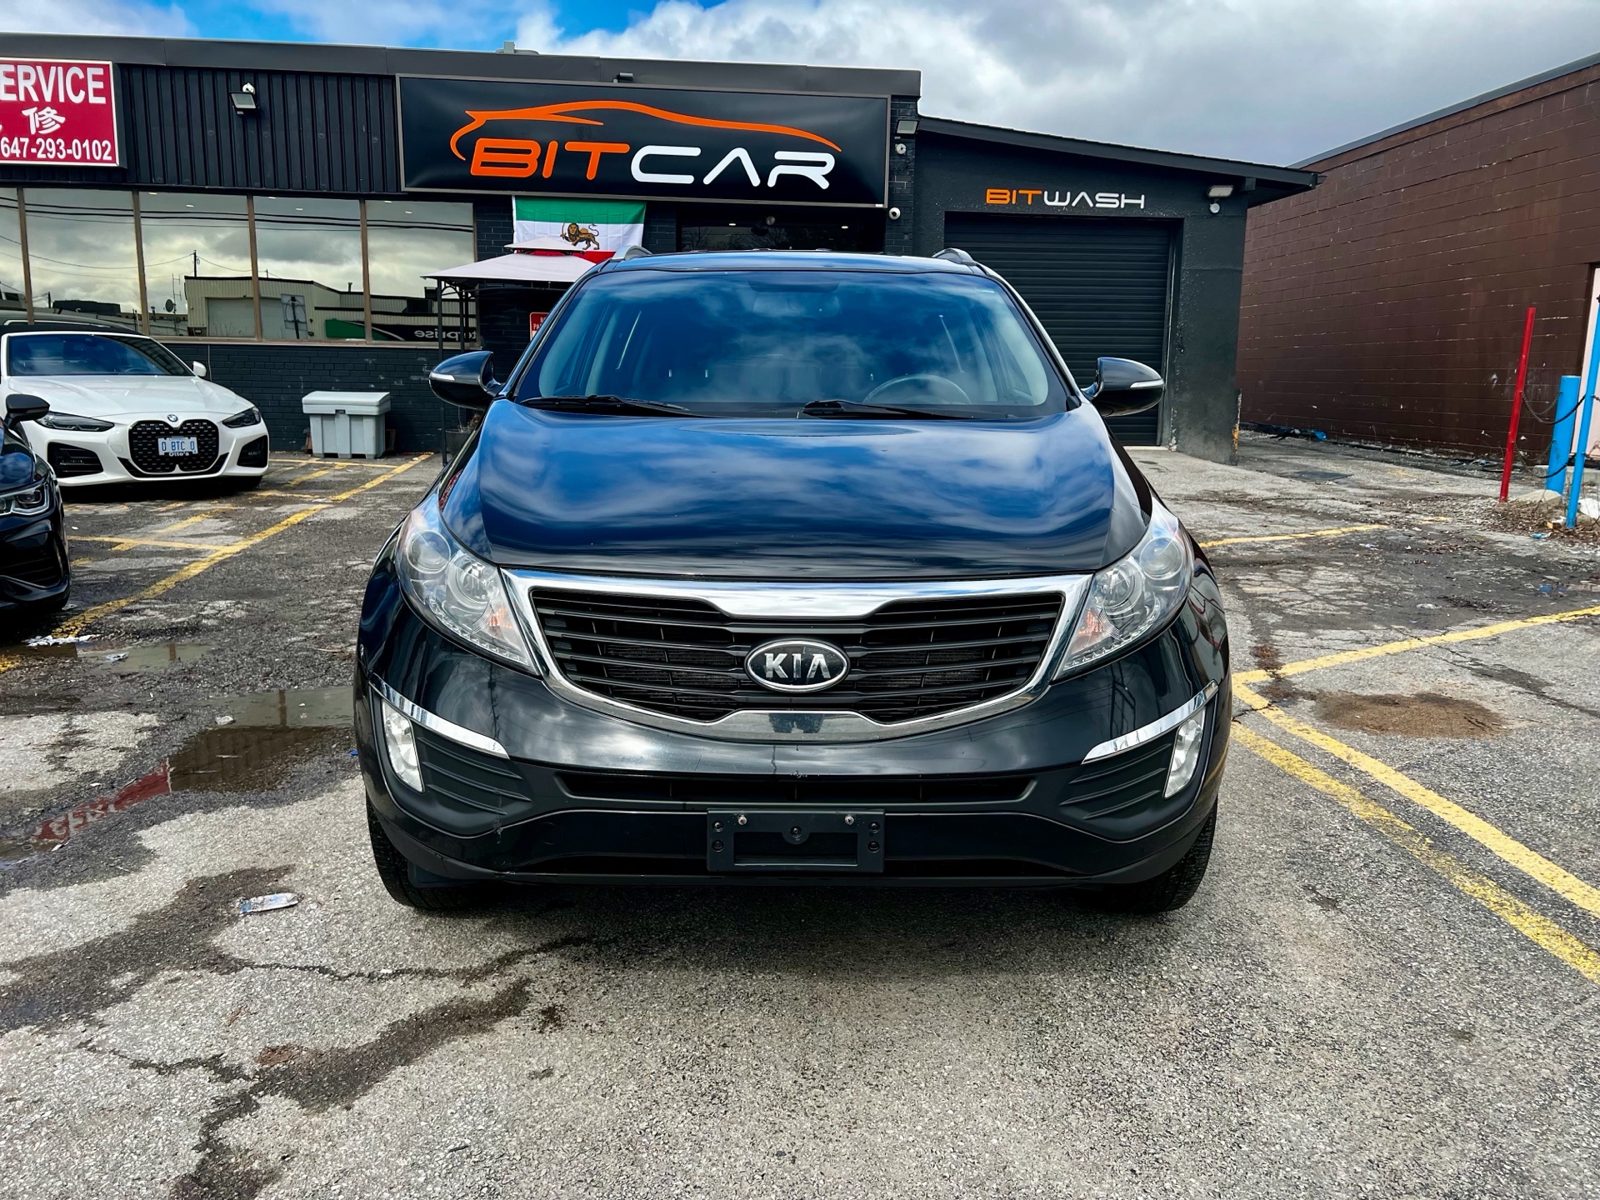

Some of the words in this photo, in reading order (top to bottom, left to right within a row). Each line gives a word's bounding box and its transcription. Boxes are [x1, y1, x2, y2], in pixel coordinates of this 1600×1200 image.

[21, 106, 66, 135] 修
[0, 136, 113, 161] 647-293-0102
[470, 137, 836, 190] BITCAR
[986, 188, 1145, 209] BITWASH
[764, 653, 832, 679] KIA
